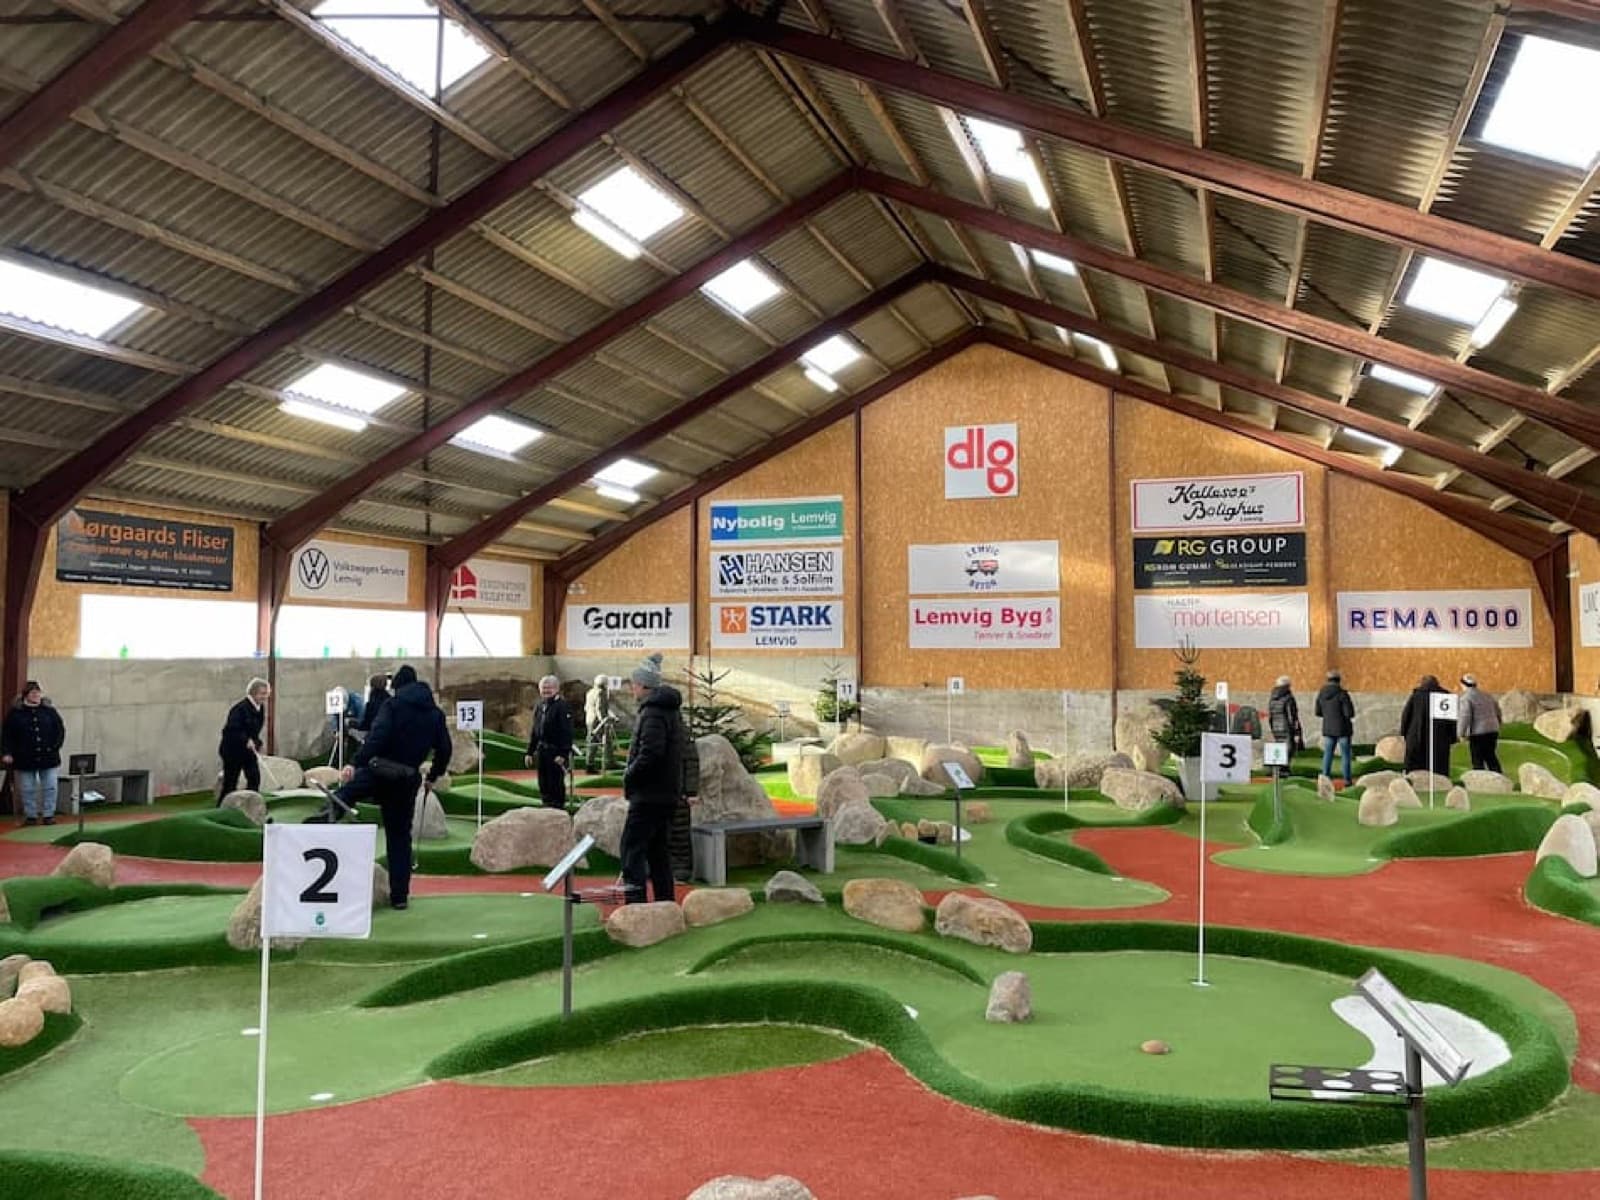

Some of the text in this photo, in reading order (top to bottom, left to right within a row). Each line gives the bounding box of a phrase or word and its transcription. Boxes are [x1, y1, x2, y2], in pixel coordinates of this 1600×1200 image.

[948, 428, 1014, 494] dlg
[1183, 501, 1264, 521] Bolighus
[713, 511, 837, 532] Nybolig Lemvig
[183, 529, 229, 550] Fliser
[1178, 537, 1287, 555] RG GROUP
[135, 548, 148, 560] og
[746, 552, 833, 573] HANSEN
[746, 575, 778, 586] Skilte
[583, 606, 672, 630] Garant
[750, 605, 832, 627] STARK
[915, 607, 992, 628] Lemvig
[1001, 607, 1041, 628] Byg
[1174, 608, 1280, 628] mortensen
[1350, 608, 1518, 629] REMA 1000
[755, 635, 797, 646] LEMVIG
[840, 683, 852, 696] 11
[329, 695, 340, 707] 12
[1439, 698, 1449, 712] 6
[460, 707, 475, 723] 13
[1219, 743, 1237, 769] 3
[299, 848, 338, 903] 2
